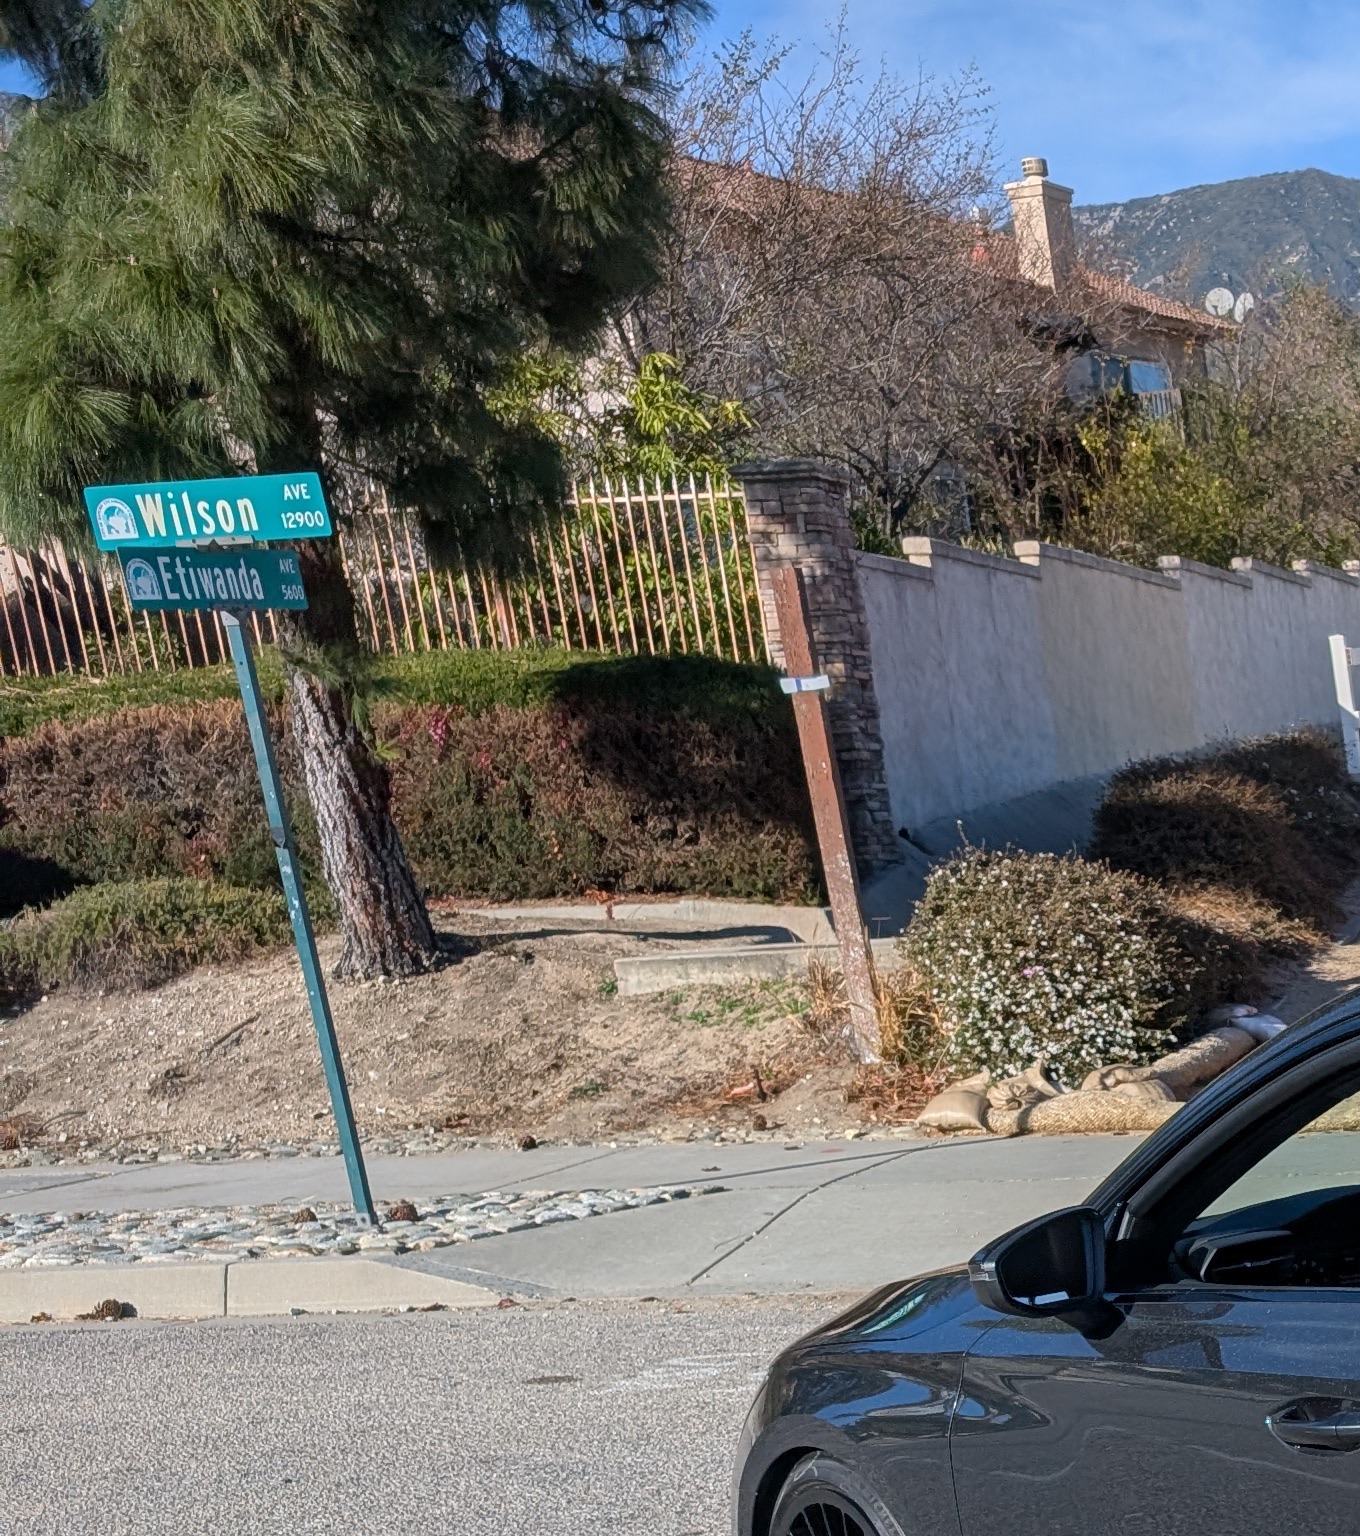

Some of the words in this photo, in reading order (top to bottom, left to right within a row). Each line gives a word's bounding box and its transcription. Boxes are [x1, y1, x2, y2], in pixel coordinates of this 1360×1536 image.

[283, 483, 311, 501] AVE
[135, 491, 259, 537] Wilson
[280, 511, 324, 530] 12900
[279, 558, 296, 574] AVE
[158, 555, 265, 601] Etiwanda
[282, 585, 305, 601] 5600
